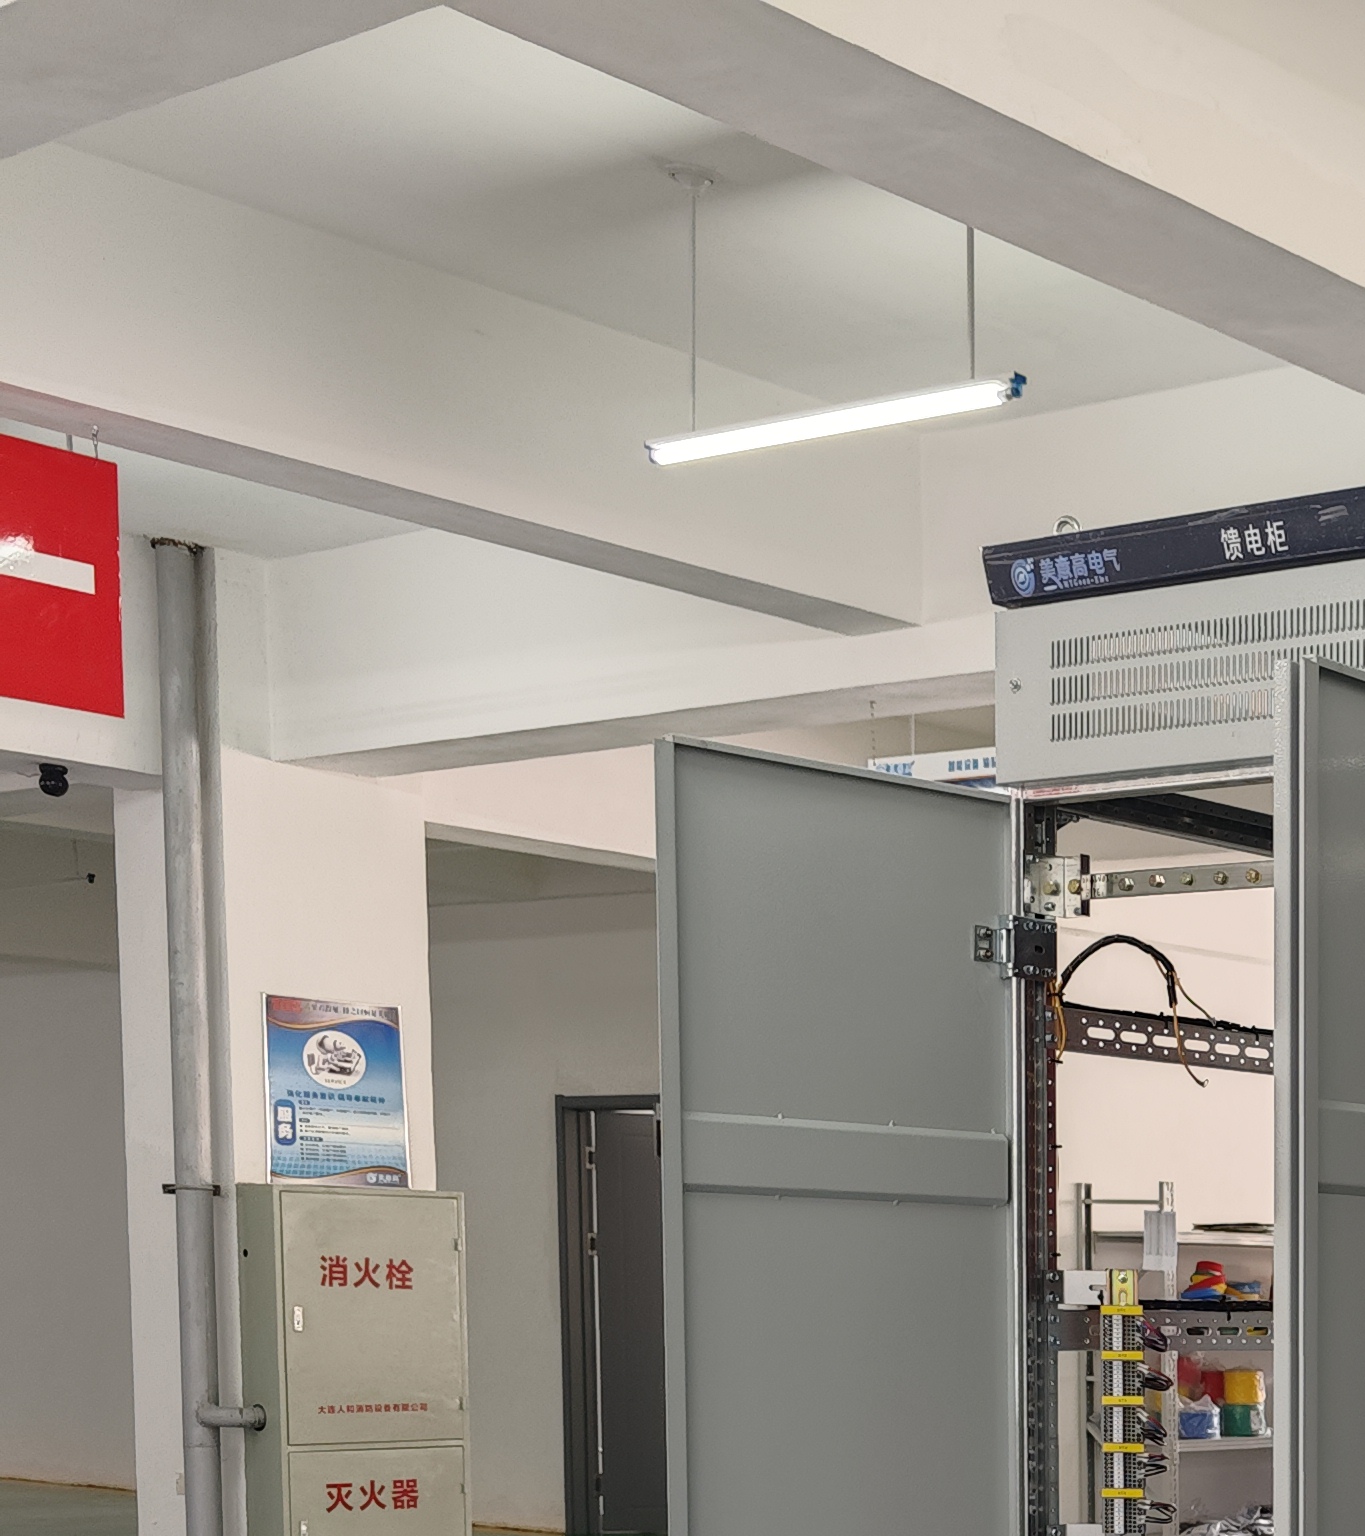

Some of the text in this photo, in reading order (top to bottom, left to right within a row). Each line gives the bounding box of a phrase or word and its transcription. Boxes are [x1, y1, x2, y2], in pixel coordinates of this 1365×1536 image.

[1220, 520, 1290, 562] 馈电柜
[319, 1254, 415, 1291] 消火栓
[325, 1478, 420, 1514] 灭火器
